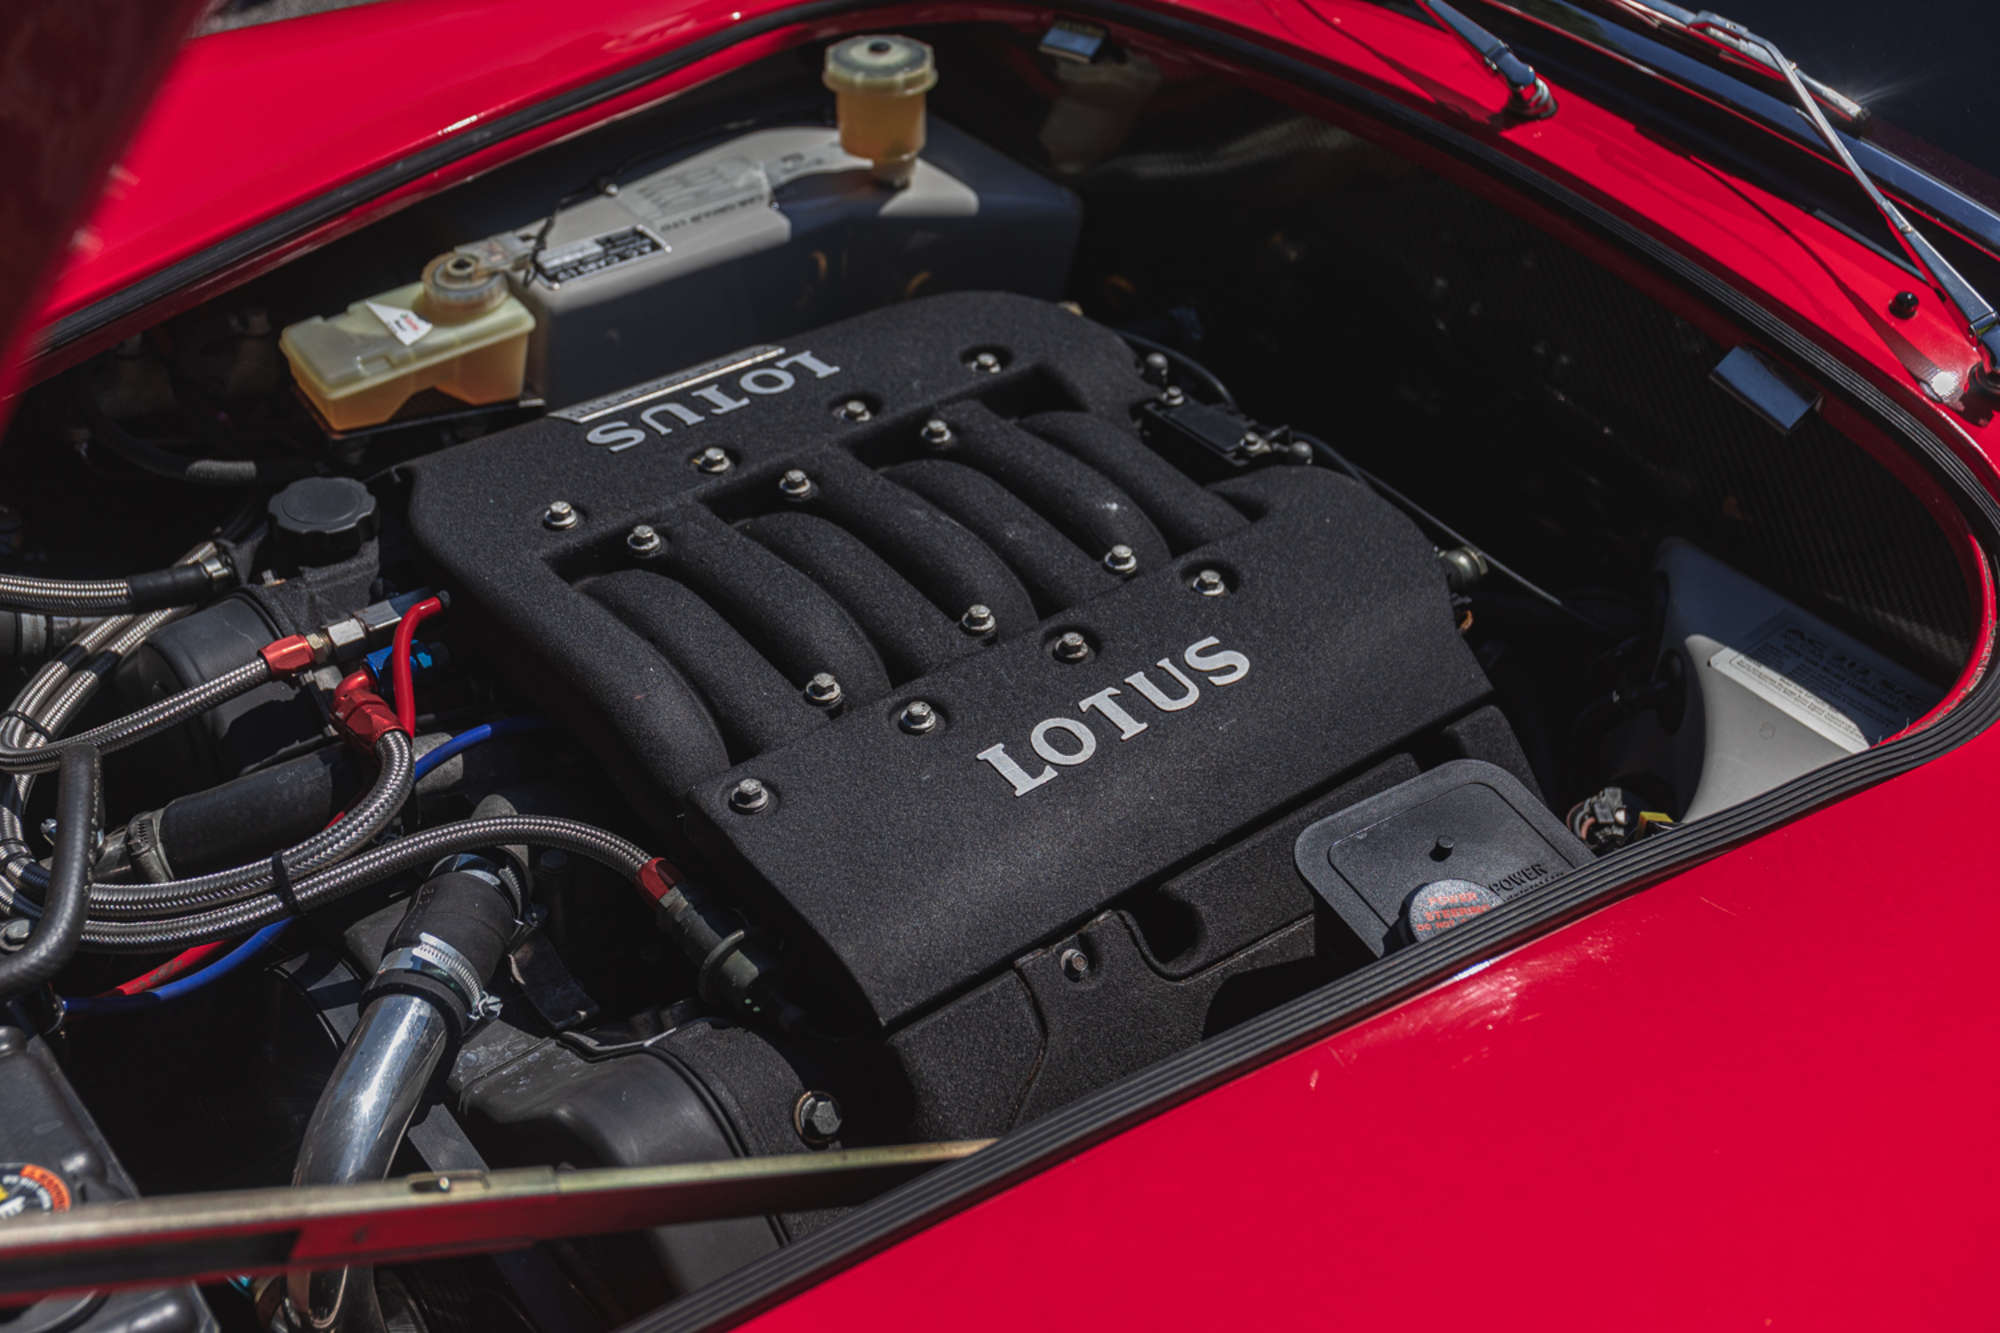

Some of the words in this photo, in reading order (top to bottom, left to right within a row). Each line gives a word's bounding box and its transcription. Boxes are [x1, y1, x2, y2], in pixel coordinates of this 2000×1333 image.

[586, 351, 840, 453] LOTUS
[976, 636, 1251, 797] LOTUS
[1427, 891, 1479, 907] POWER
[1488, 863, 1549, 894] POWER
